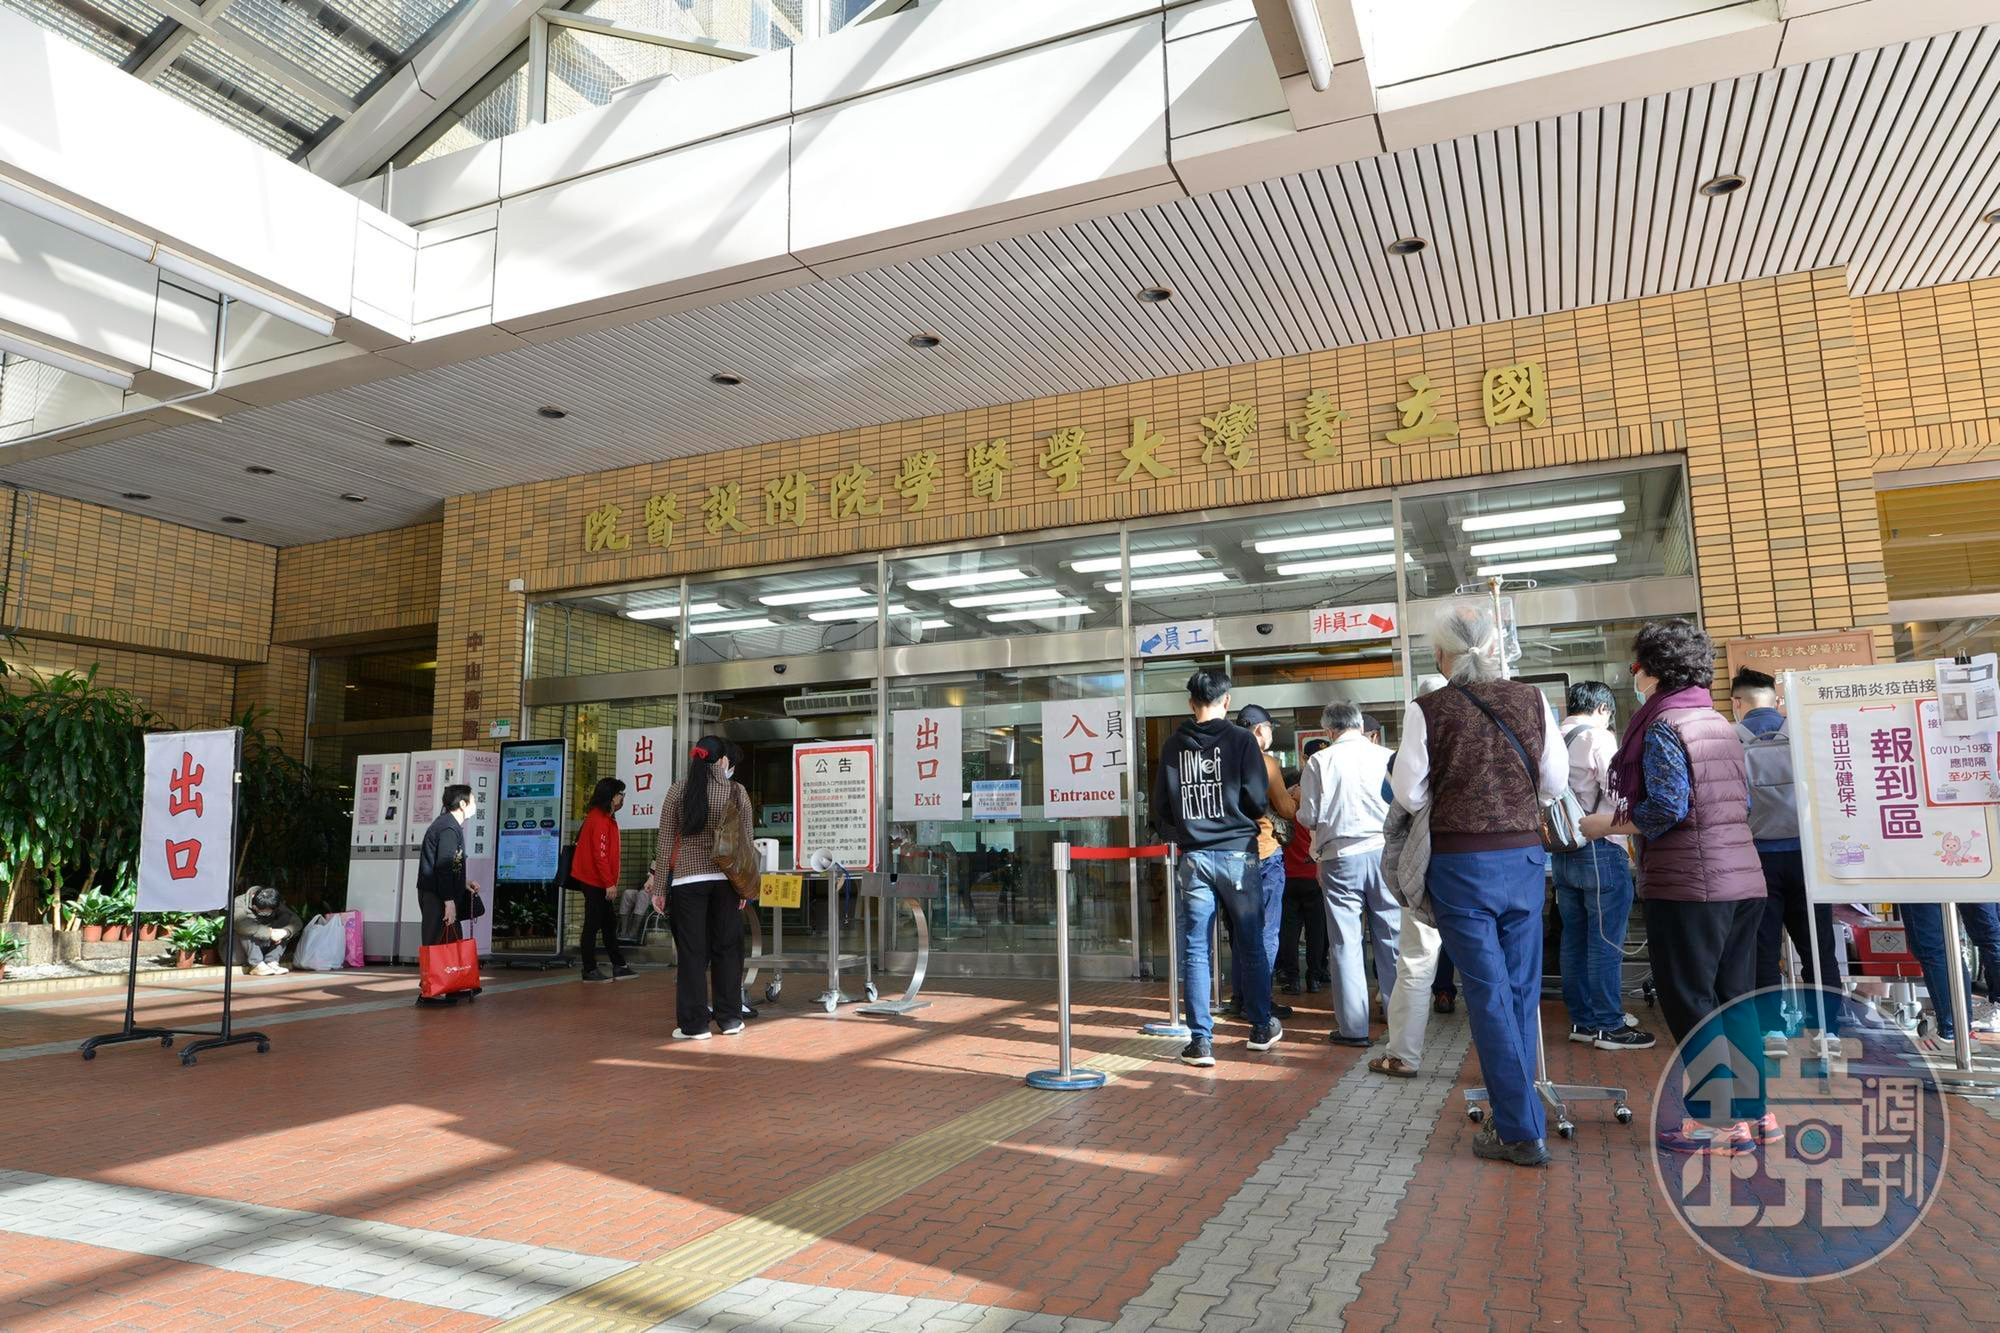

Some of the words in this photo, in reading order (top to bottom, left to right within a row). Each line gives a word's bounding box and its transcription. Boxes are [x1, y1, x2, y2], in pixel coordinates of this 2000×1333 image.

[1313, 611, 1367, 634] 非員工
[1164, 626, 1209, 651] 員工
[916, 717, 939, 781] 出口
[1062, 714, 1099, 775] 入口
[1102, 710, 1127, 768] 員工
[634, 735, 654, 793] 出口
[815, 757, 852, 774] 公告
[1830, 723, 1857, 819] 請出示健保卡
[1948, 770, 1991, 782] 至少7天
[1950, 756, 1987, 768] 應間隔
[1050, 789, 1116, 803] Entrance
[1870, 727, 1924, 840] 報到區
[631, 804, 654, 816] Exit
[914, 793, 941, 807] Exit
[1181, 783, 1225, 820] RESPECT
[165, 751, 205, 881] 出口
